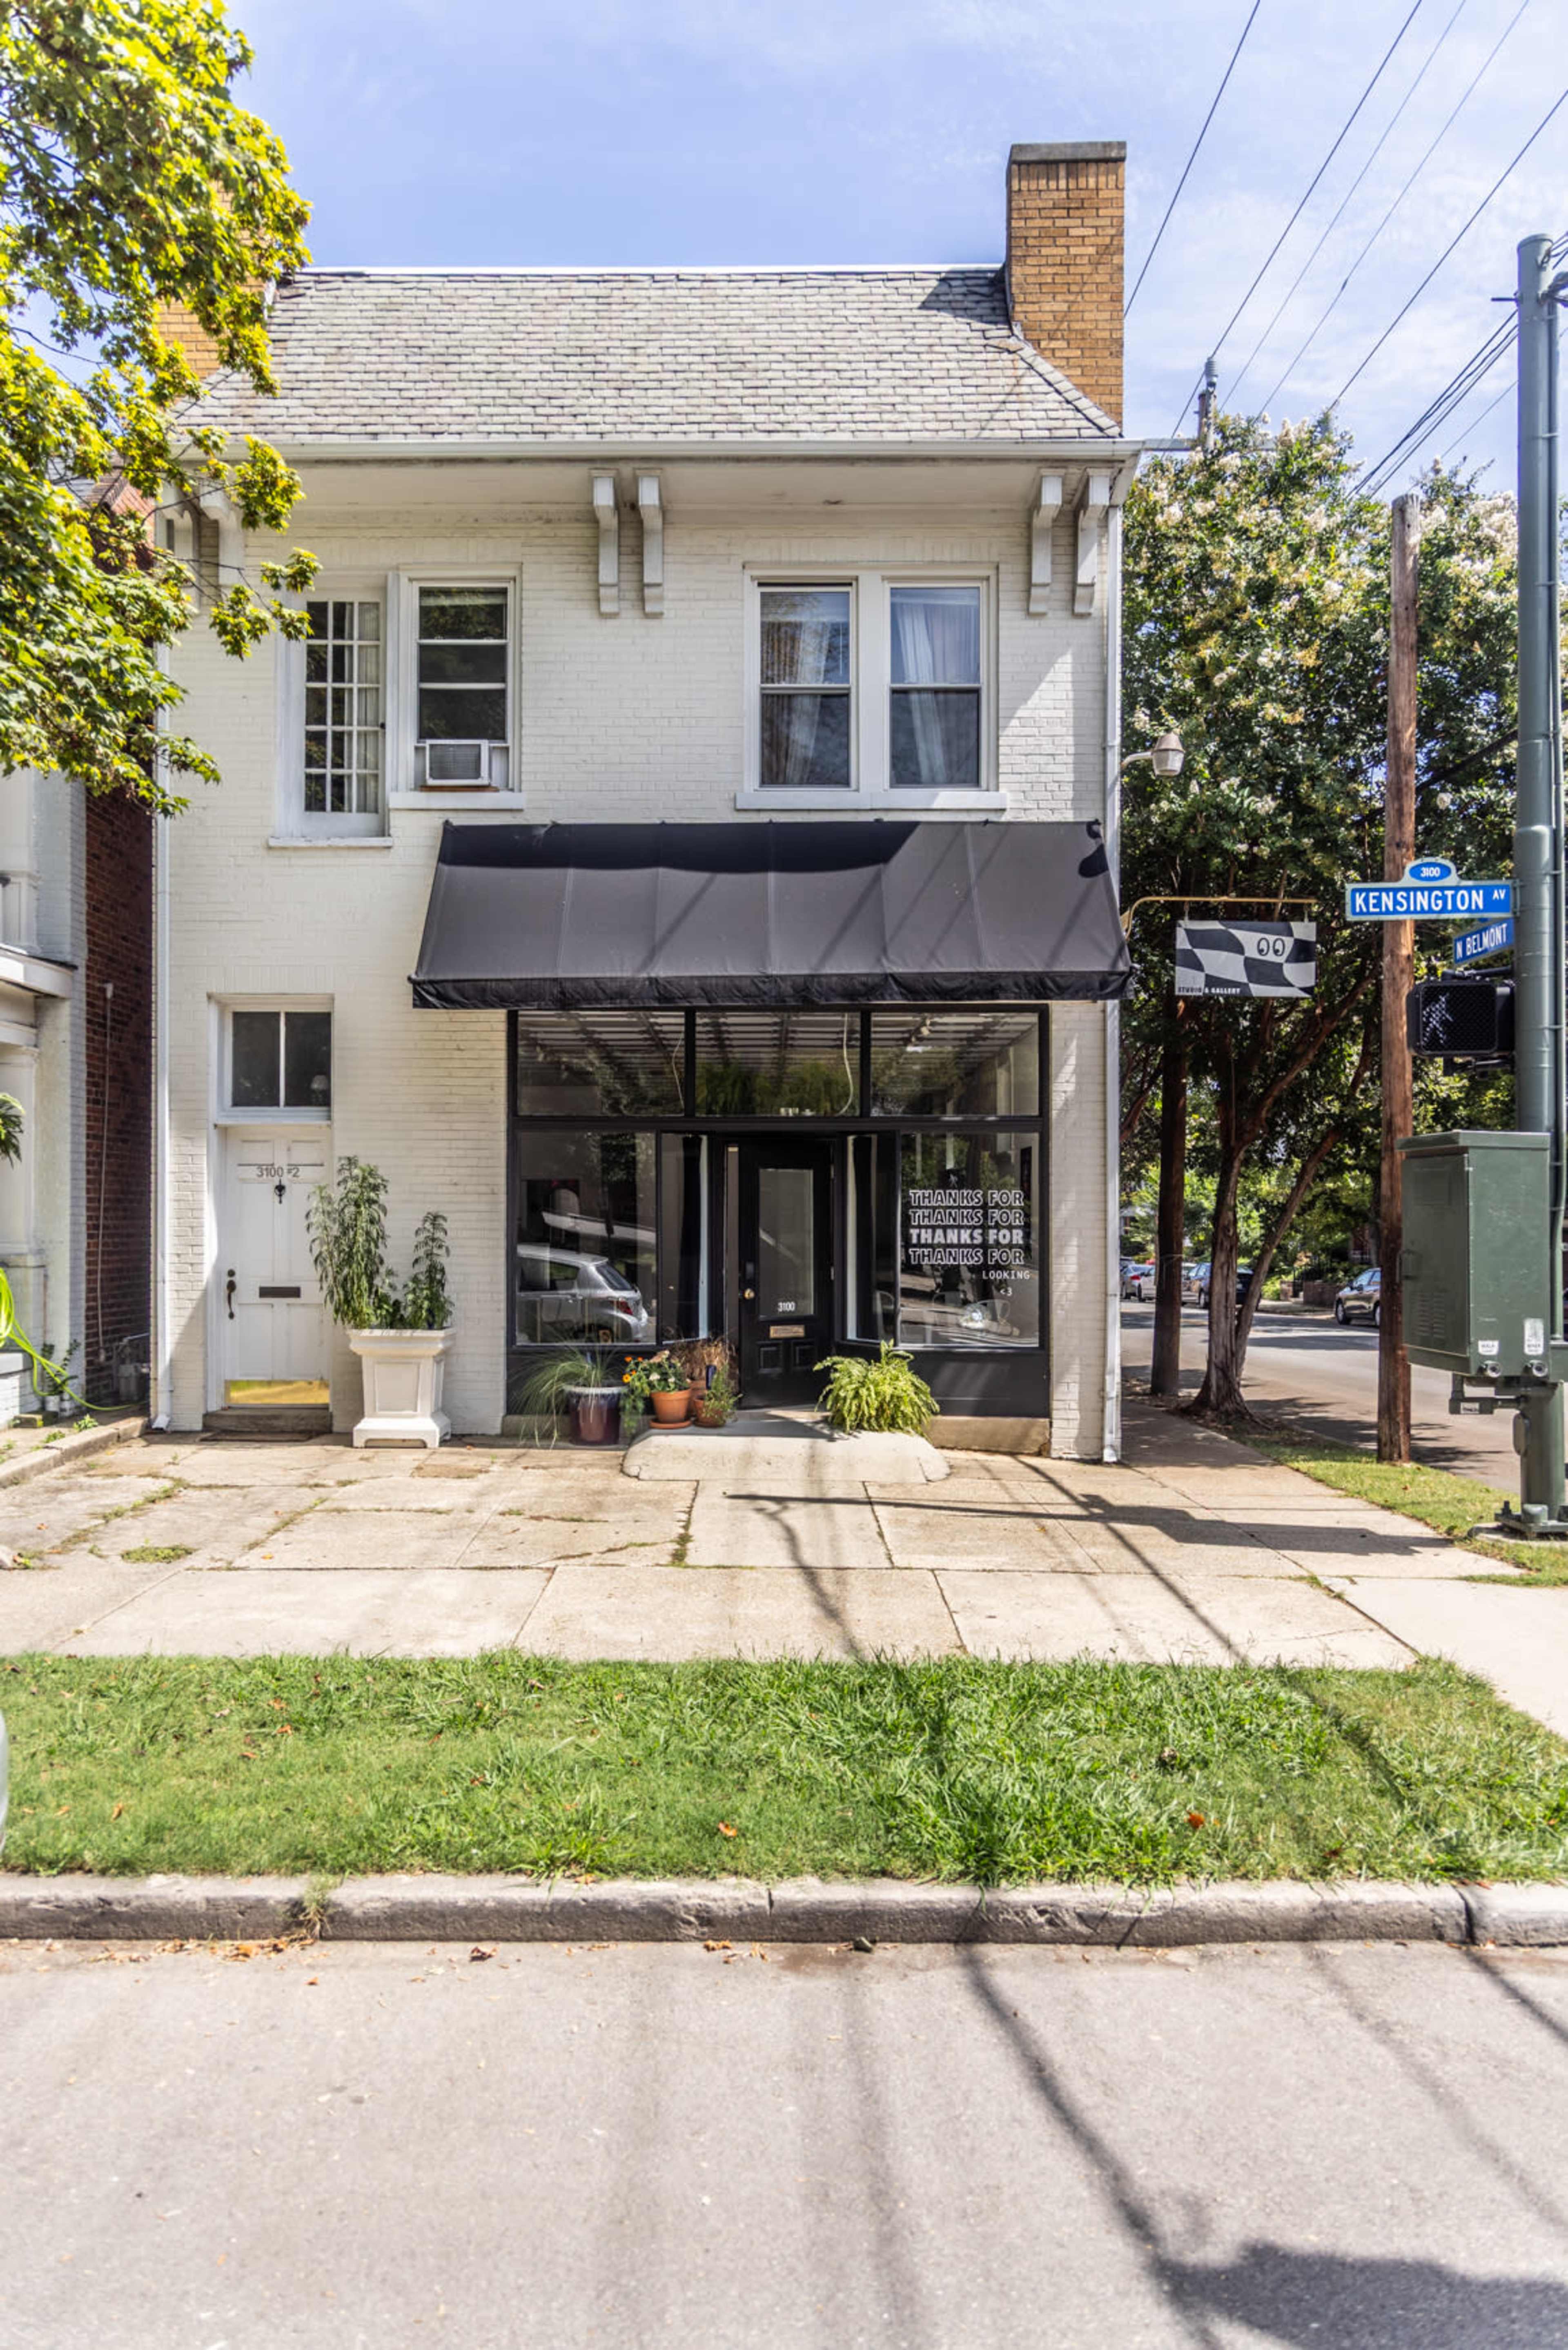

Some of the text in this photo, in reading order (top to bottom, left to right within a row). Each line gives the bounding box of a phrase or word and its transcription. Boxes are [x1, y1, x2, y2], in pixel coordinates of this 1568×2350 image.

[1421, 866, 1441, 878] 3100
[1355, 889, 1506, 913] KENSINGTON AV
[1456, 923, 1507, 960] N BELMONT
[256, 1166, 284, 1177] 3100
[909, 1190, 1024, 1206] THANKS FOR
[909, 1209, 1024, 1225] THANKS FOR
[910, 1229, 1023, 1244] THANKS FOR
[909, 1249, 1024, 1265] THANKS FOR
[982, 1270, 1030, 1279] LOOKING
[777, 1301, 795, 1312] 3100
